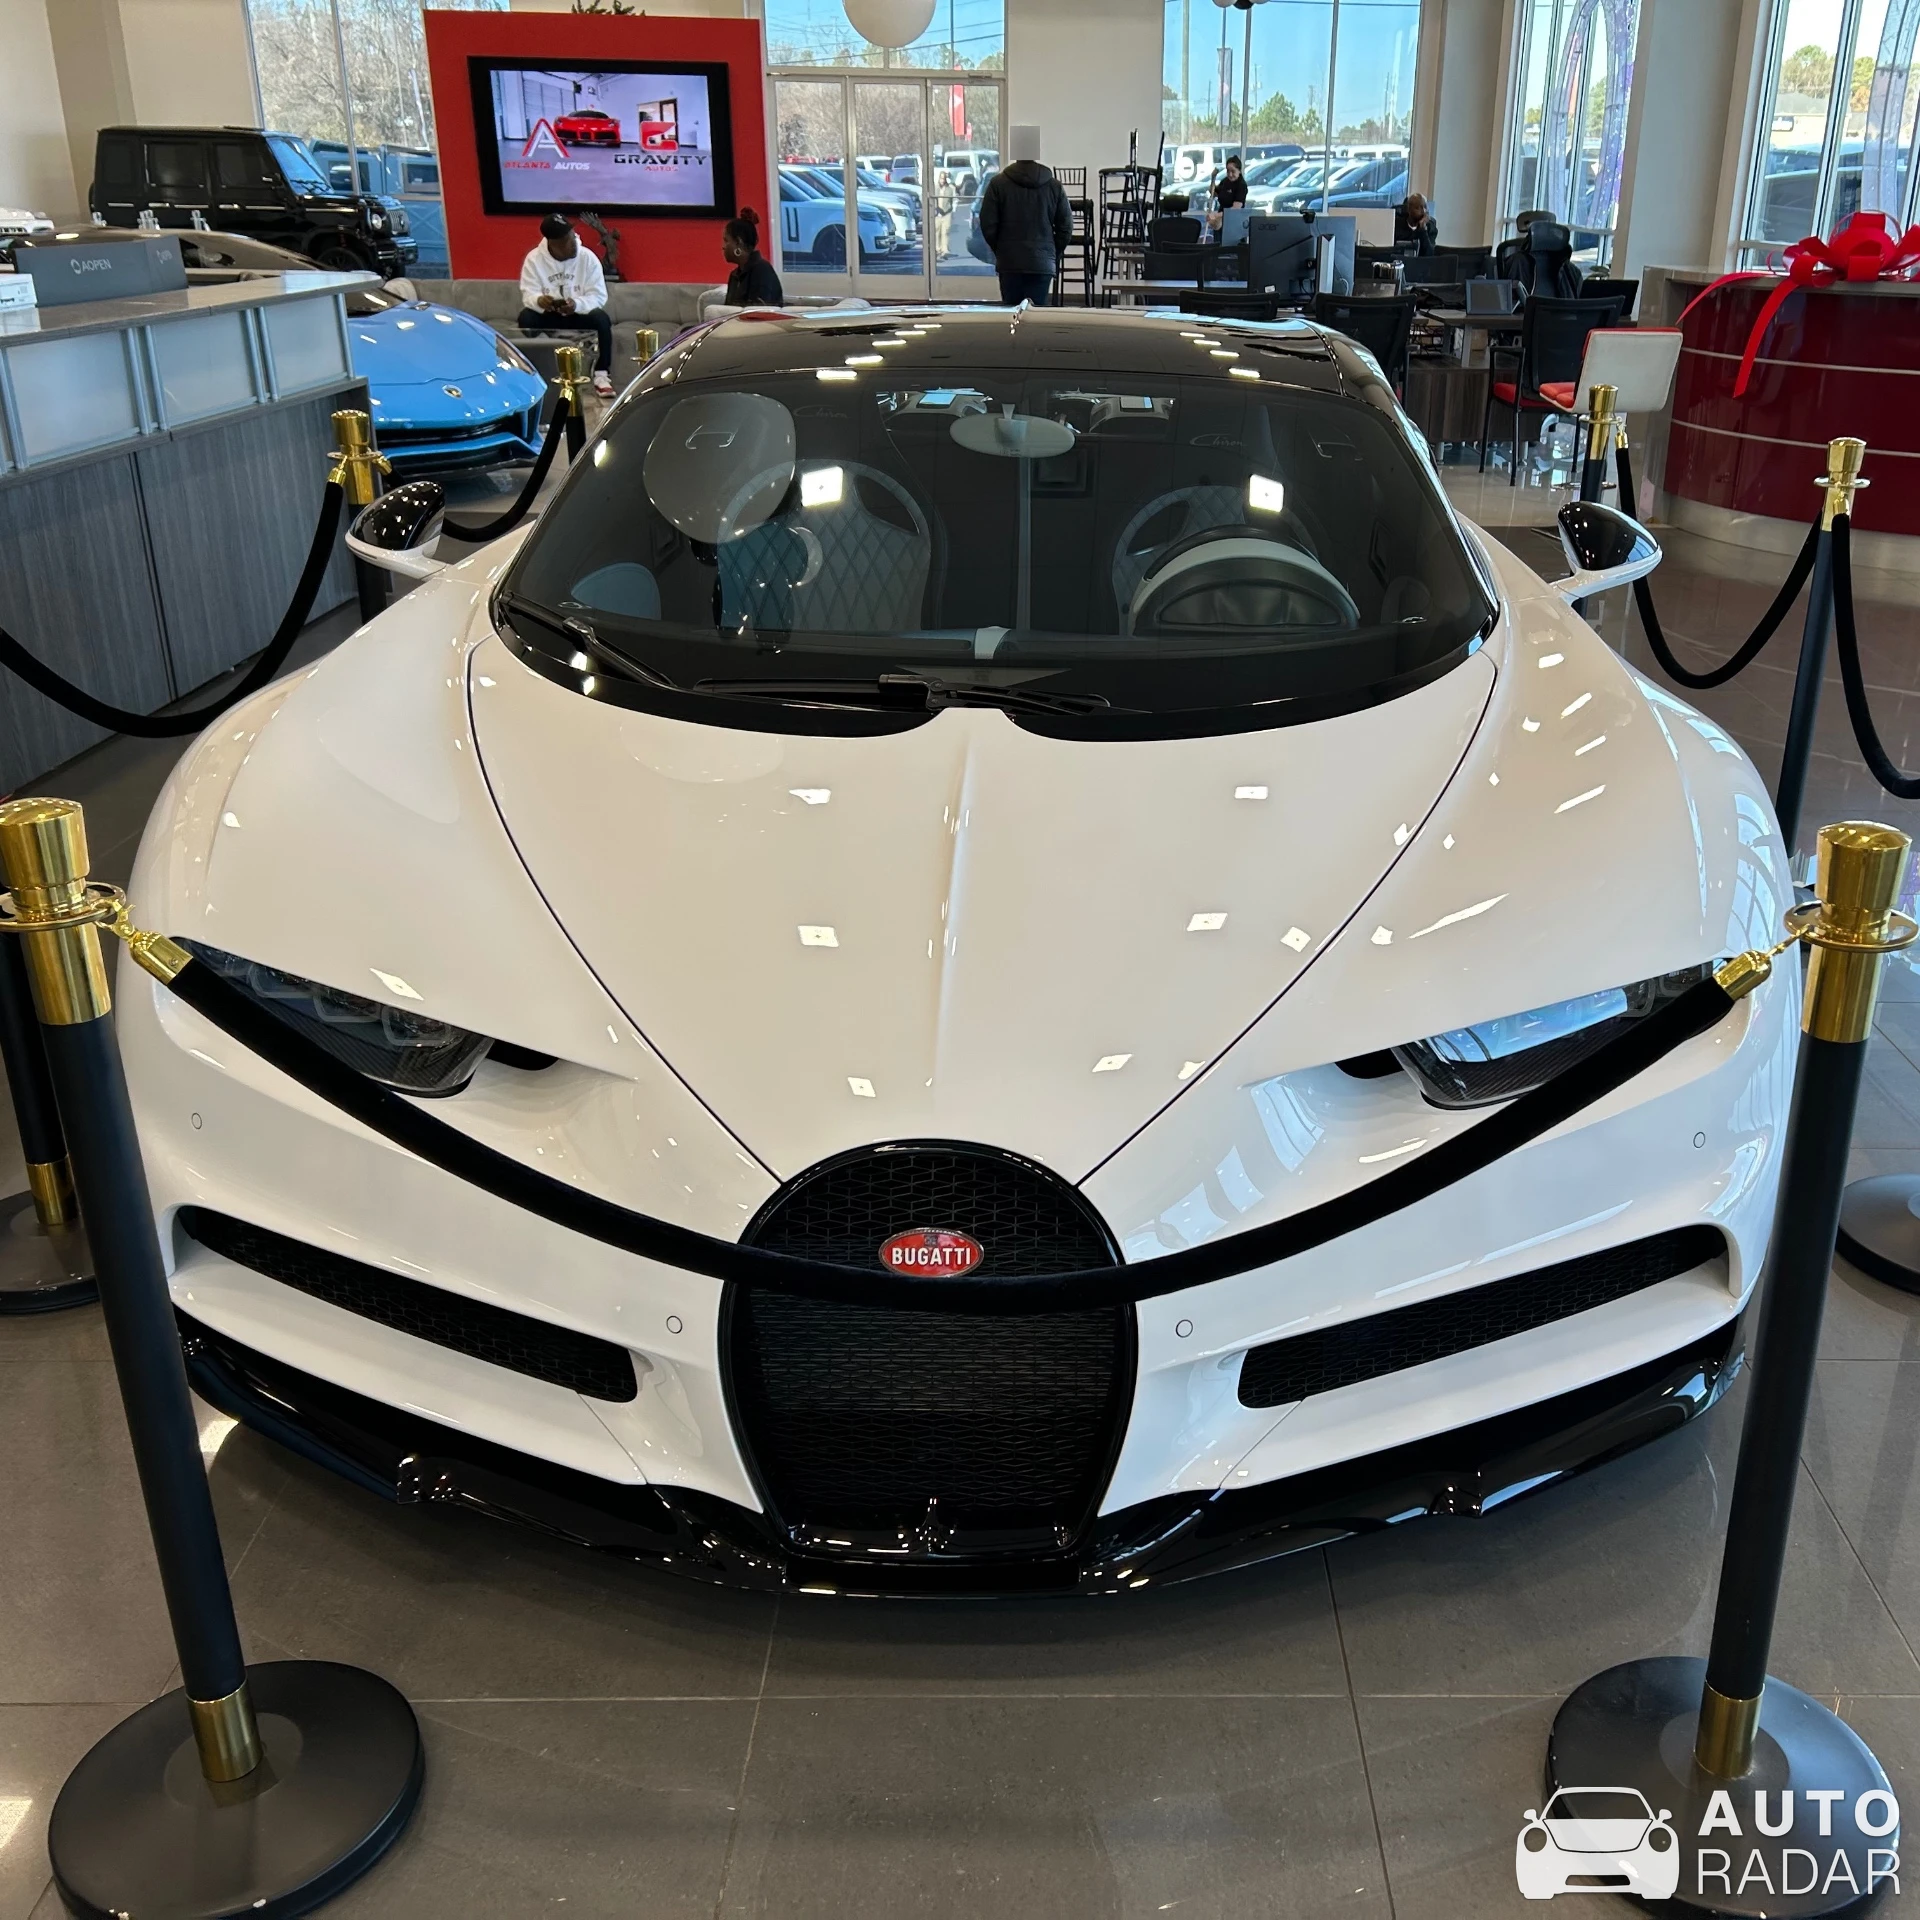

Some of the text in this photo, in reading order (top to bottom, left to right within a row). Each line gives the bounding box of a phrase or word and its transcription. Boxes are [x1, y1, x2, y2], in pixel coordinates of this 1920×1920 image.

[504, 161, 591, 170] ATLANTA AUTOS
[614, 154, 708, 166] GRAVITY
[82, 258, 112, 272] AOPEN
[1190, 433, 1246, 446] Chiron
[891, 1247, 971, 1265] BUGATTI
